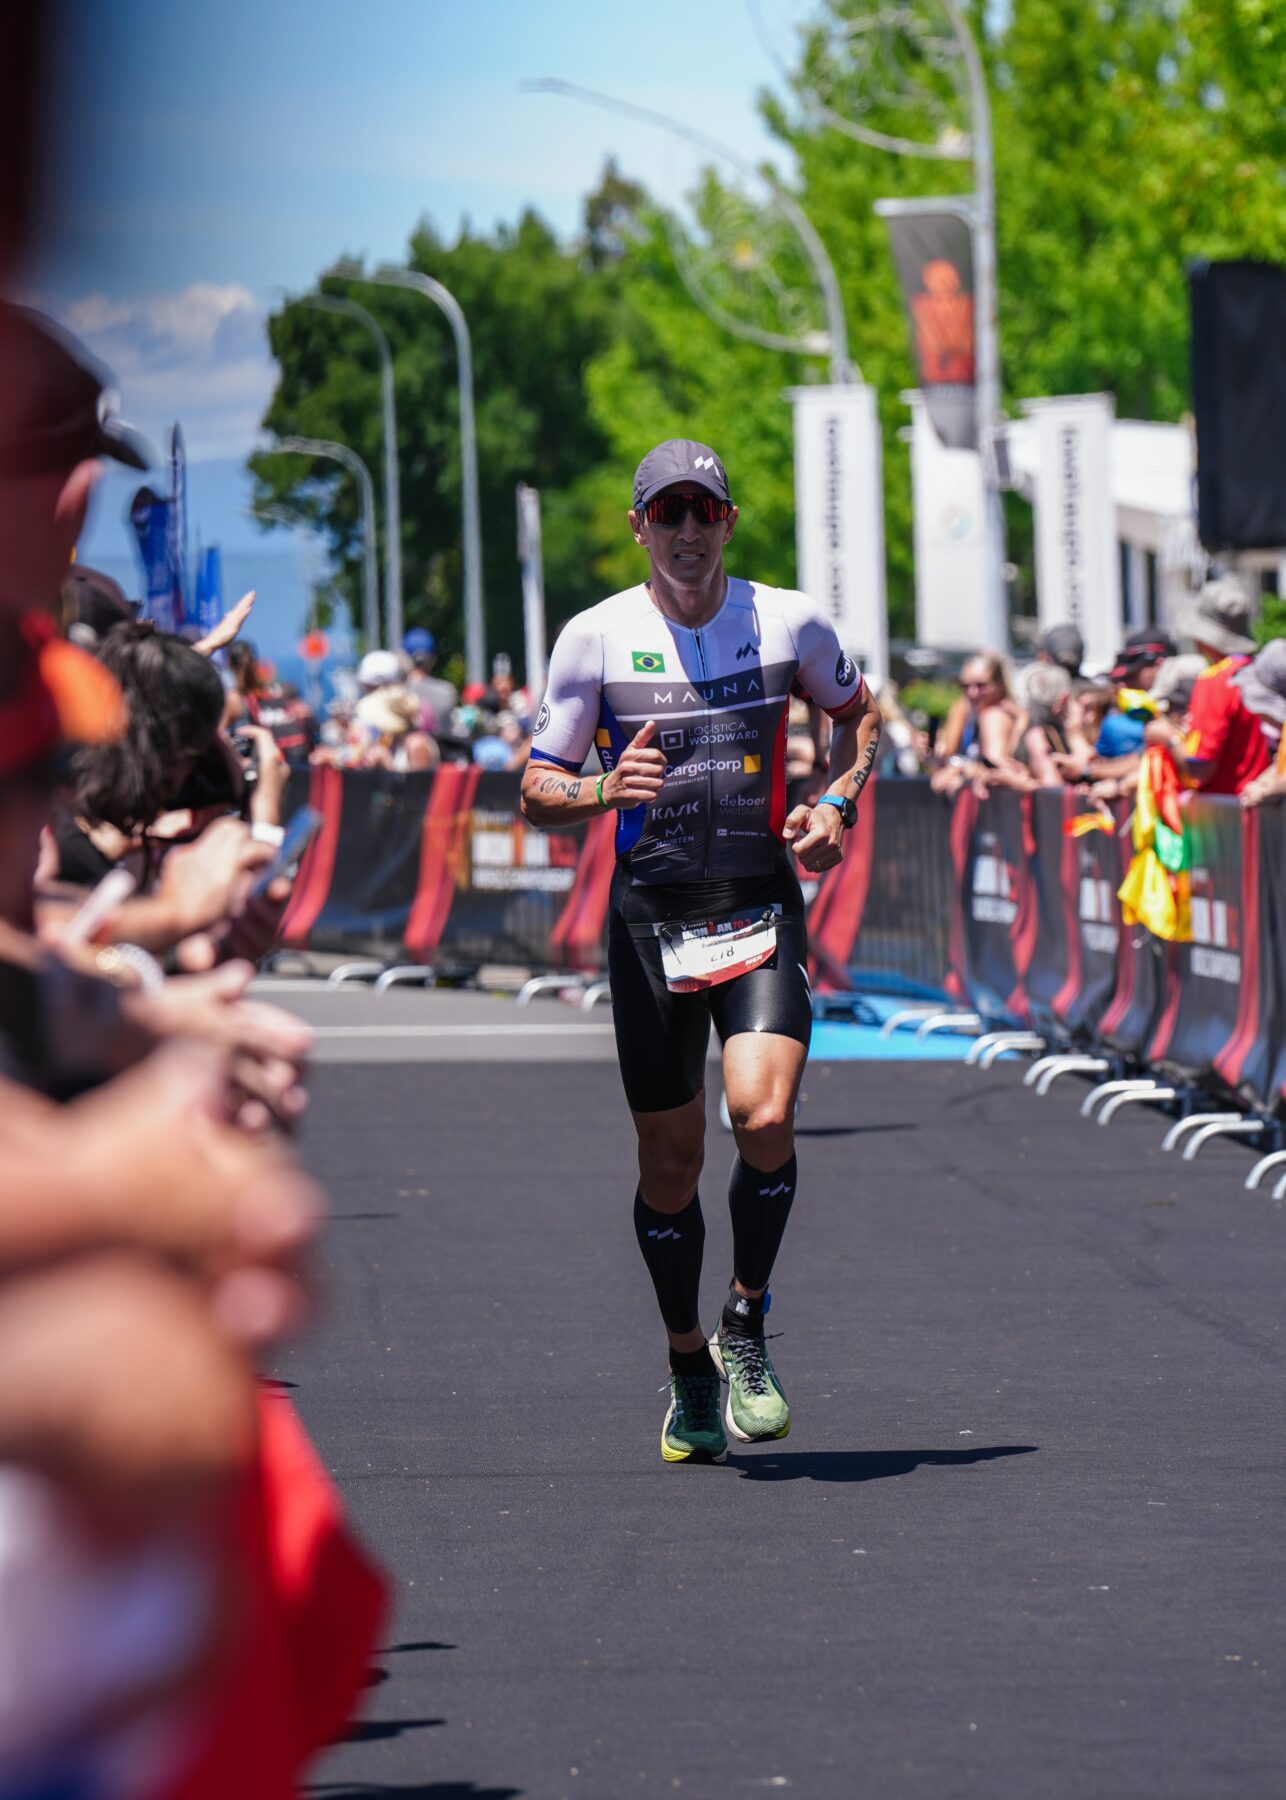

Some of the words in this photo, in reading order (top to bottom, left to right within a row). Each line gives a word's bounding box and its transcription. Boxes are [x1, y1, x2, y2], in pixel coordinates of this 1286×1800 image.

[654, 679, 760, 704] MAUNA
[689, 729, 759, 745] WOODWARD
[664, 759, 741, 778] CargoCorp
[651, 800, 700, 821] KASK
[656, 835, 695, 849] MAURTEN
